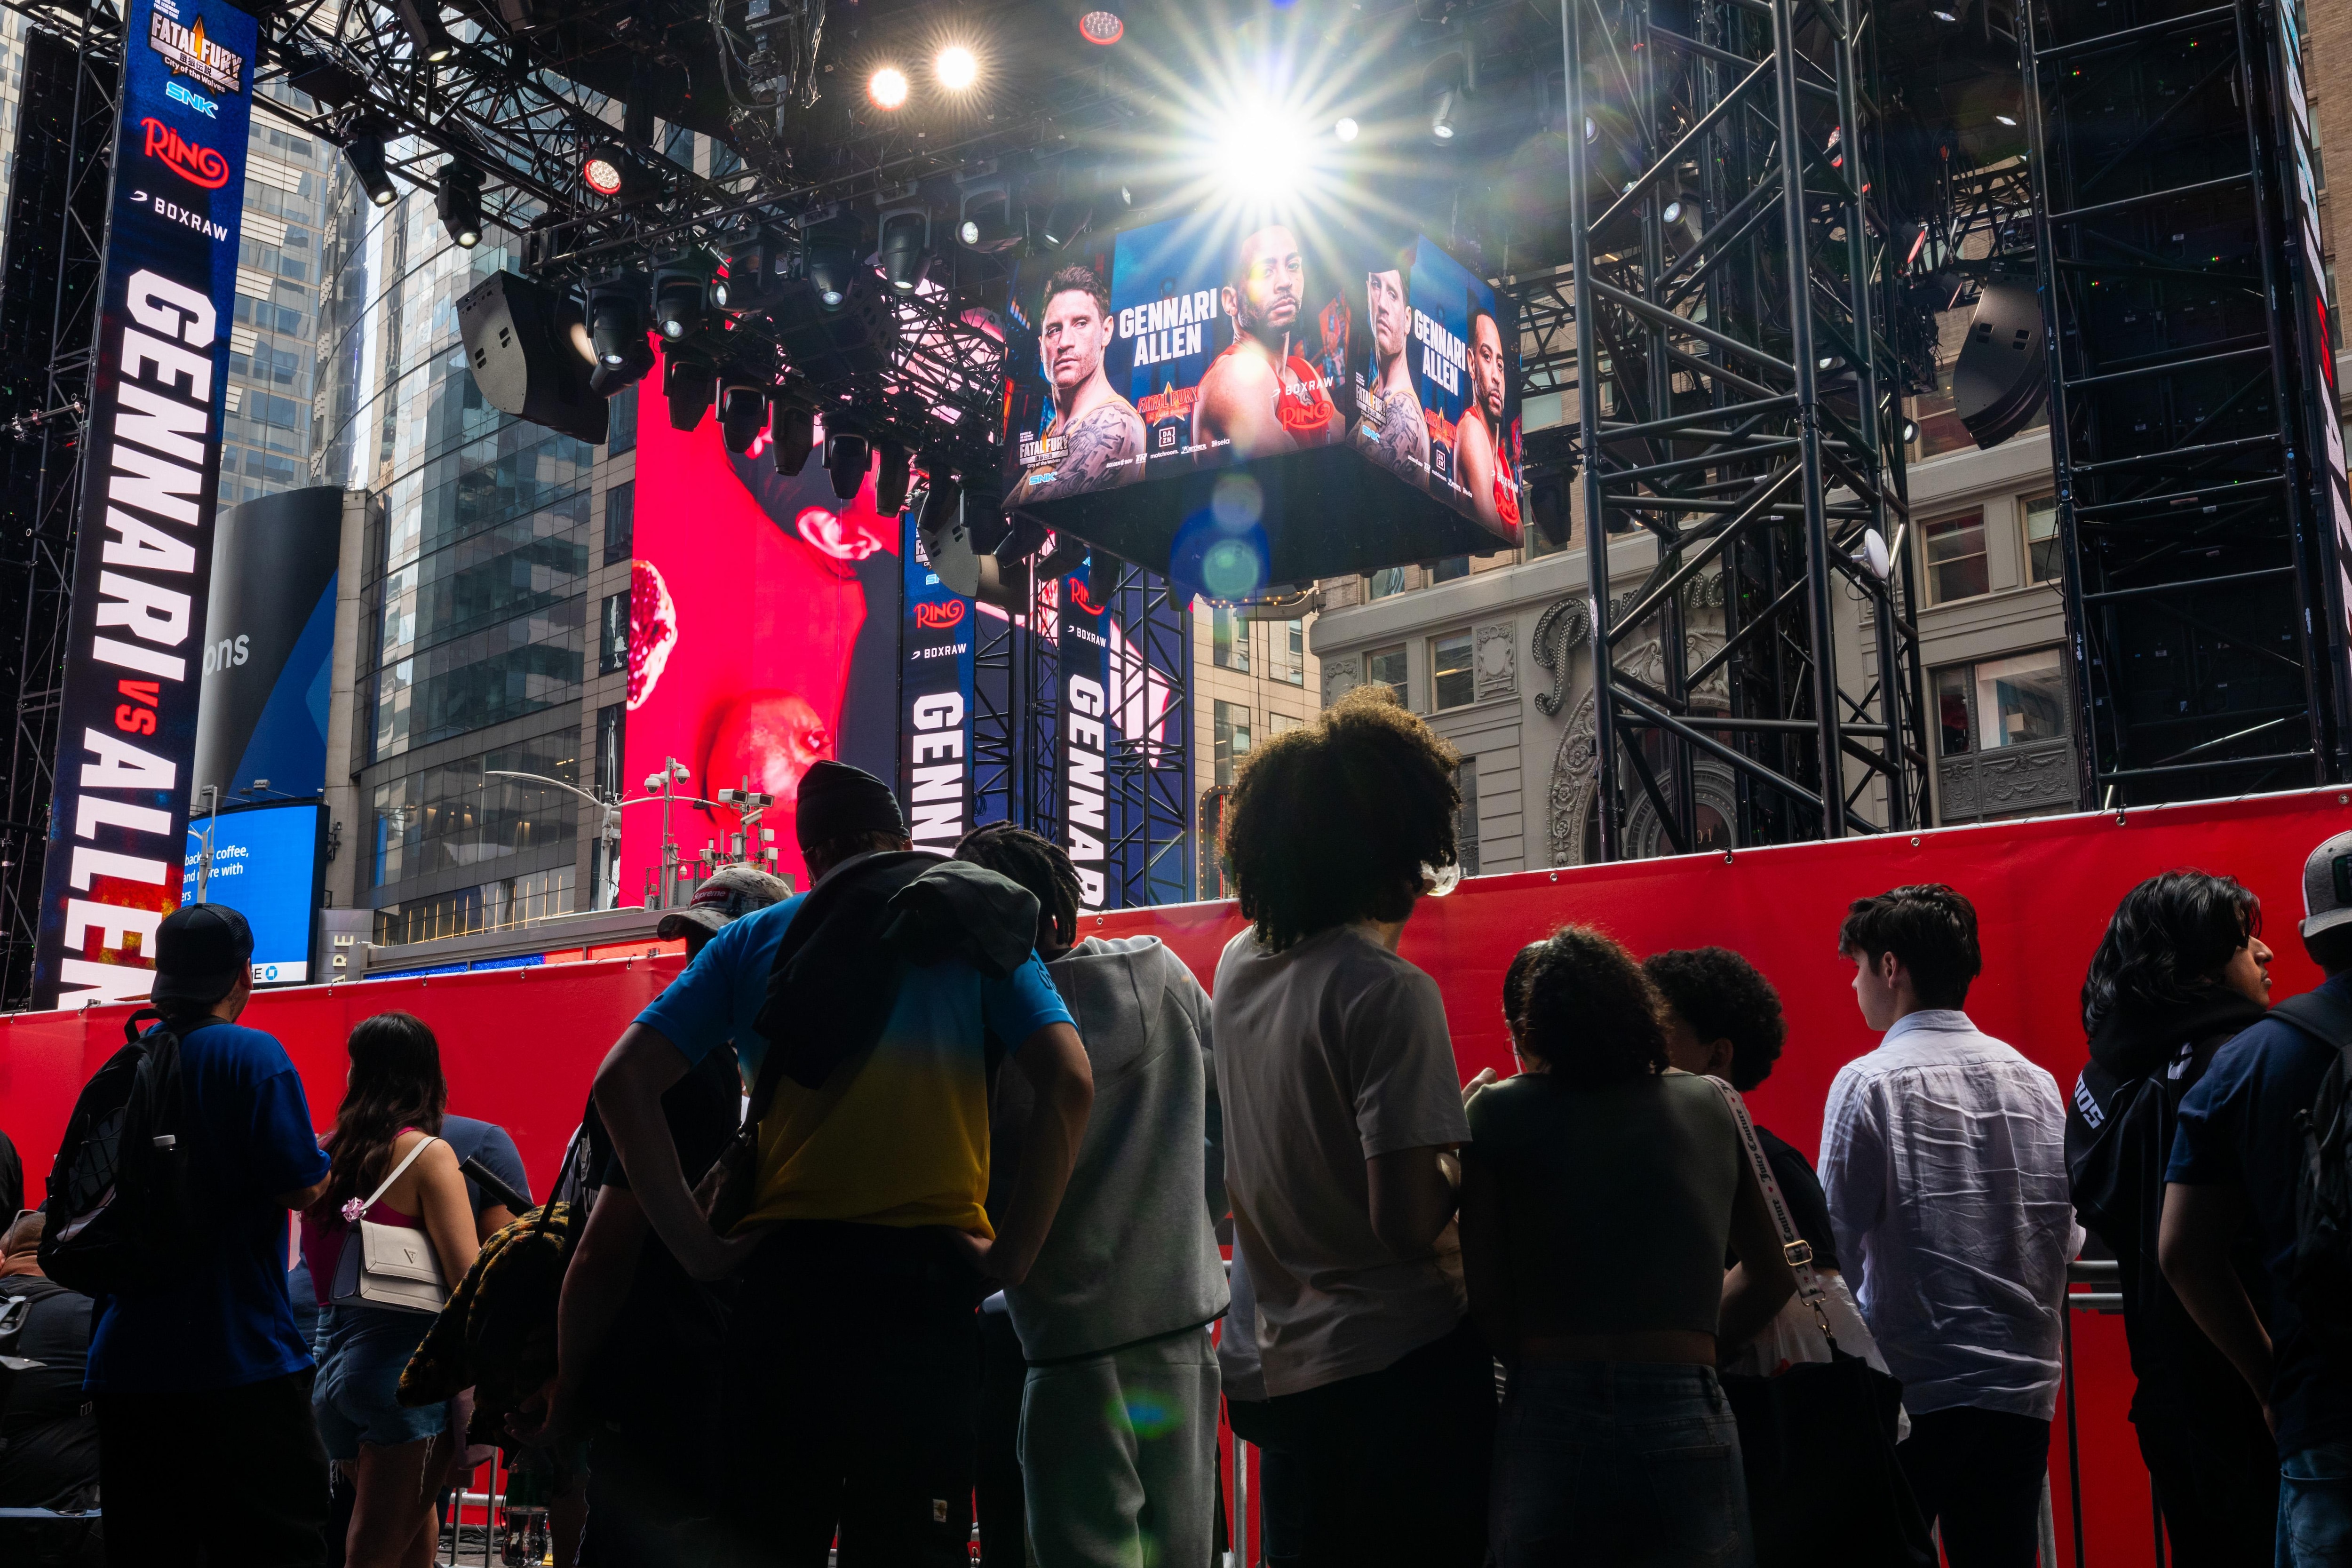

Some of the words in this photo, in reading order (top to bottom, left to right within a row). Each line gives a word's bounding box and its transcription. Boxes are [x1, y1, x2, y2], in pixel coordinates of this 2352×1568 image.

[151, 12, 198, 57] FATAL
[200, 38, 242, 79] FURY
[165, 56, 179, 70] City
[189, 70, 200, 80] the
[201, 75, 225, 93] Wolves
[166, 81, 218, 119] SNK
[155, 197, 228, 242] BOXRAW
[1120, 287, 1217, 339] GENNARI
[1134, 323, 1201, 367] ALLEN
[1414, 309, 1466, 372] GENNARI
[1286, 376, 1334, 396] BOXRAW
[1422, 346, 1458, 396] ALLEN
[1136, 394, 1169, 414] FATAL
[1169, 386, 1200, 407] FURY
[1356, 384, 1372, 407] FATAL
[1020, 440, 1044, 458] FATAL
[1046, 435, 1069, 453] FURY
[1362, 424, 1380, 443] SNK
[93, 269, 217, 681] GENNARI
[1029, 471, 1057, 486] SNK
[1497, 472, 1518, 493] BOXRAW
[924, 643, 967, 659] BOXRAW
[1077, 627, 1106, 648] BOXRAW
[115, 679, 160, 735] VS
[911, 692, 964, 860] GENN
[1068, 674, 1104, 912] GENNAR
[216, 845, 248, 860] coffee,
[183, 869, 195, 884] and
[221, 862, 243, 876] with
[692, 891, 726, 901] Supreme
[1736, 1108, 1757, 1151] Couture
[1754, 1153, 1772, 1183] Juicy
